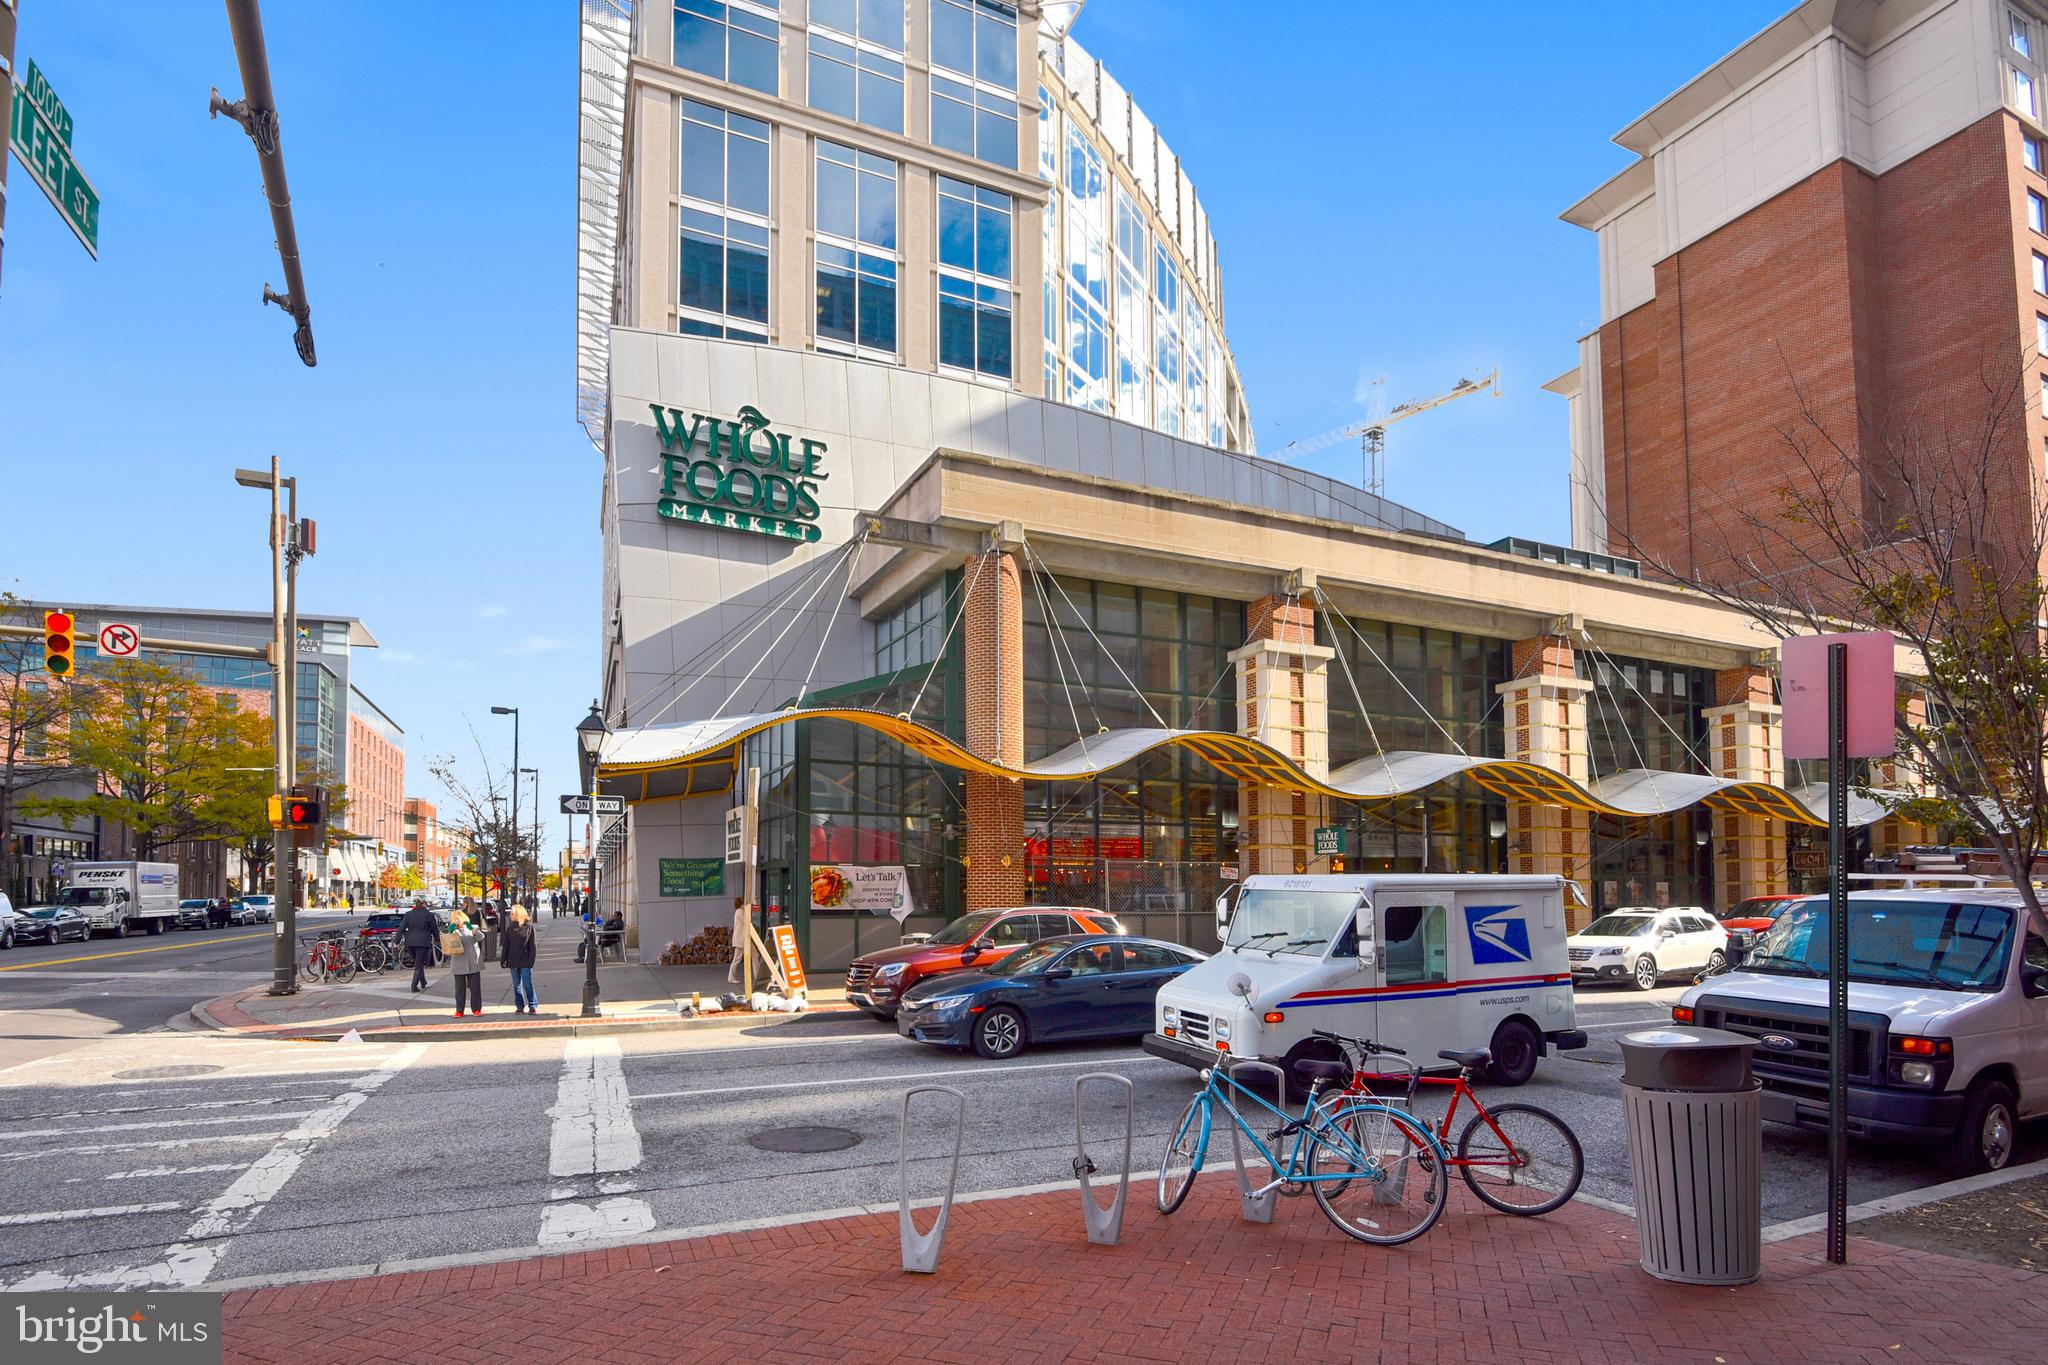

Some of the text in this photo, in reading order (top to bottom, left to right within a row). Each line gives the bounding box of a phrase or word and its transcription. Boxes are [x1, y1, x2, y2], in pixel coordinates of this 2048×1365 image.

[32, 67, 63, 131] 1000
[15, 91, 91, 229] LEET ST.
[648, 403, 830, 481] WHOLE
[659, 452, 821, 521] FOODS
[671, 502, 811, 541] MARKET
[296, 639, 321, 647] YATT
[598, 801, 618, 809] WAY
[1316, 831, 1339, 842] WHOLE
[1318, 840, 1338, 850] FOODS
[686, 862, 720, 870] Growing
[78, 870, 127, 878] PENSKE
[663, 869, 705, 878] Something
[856, 872, 876, 882] Let's
[877, 872, 897, 881] Talk
[663, 877, 686, 885] Good
[1479, 995, 1530, 1006] www.usps.com
